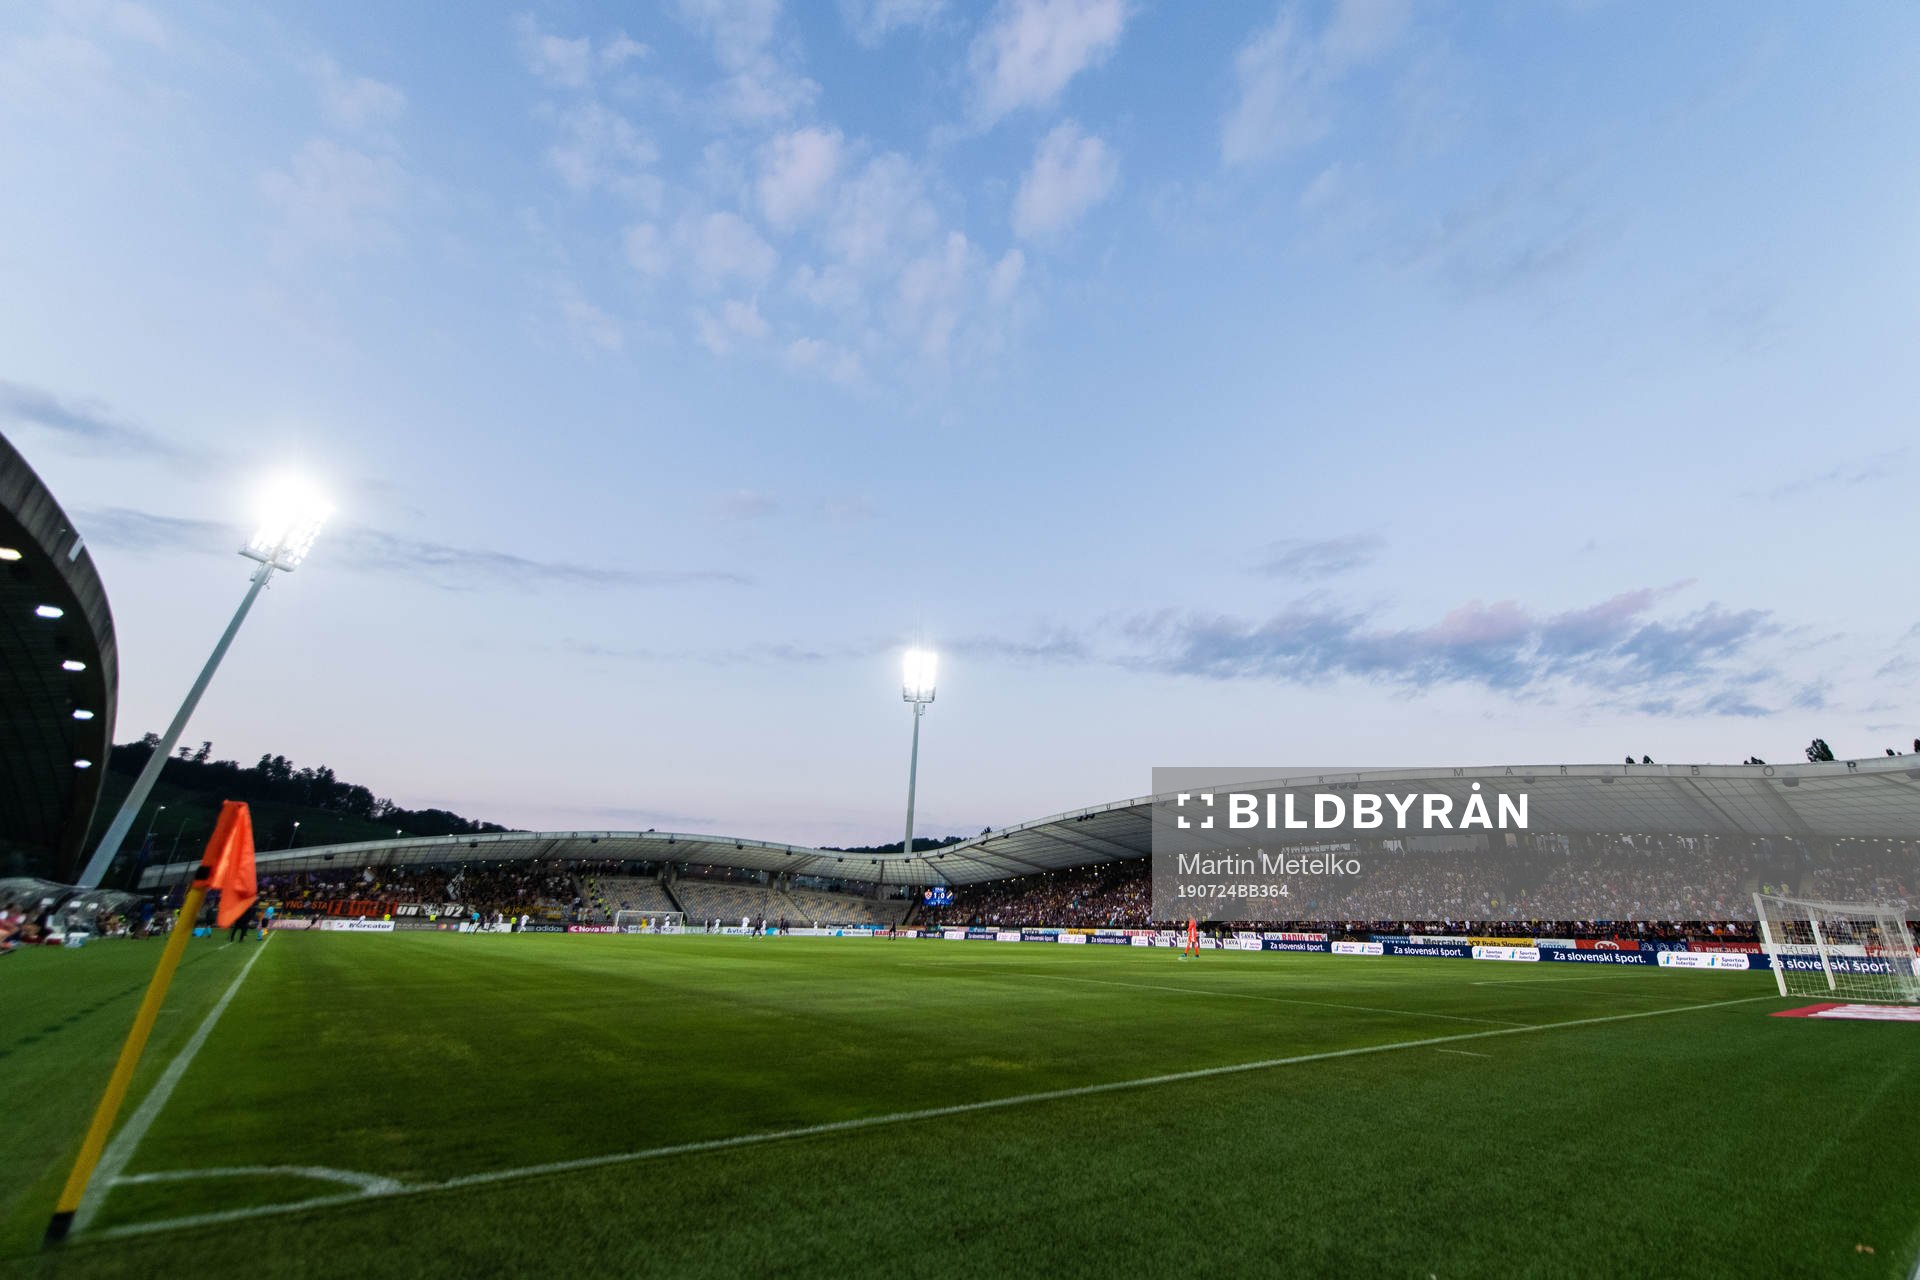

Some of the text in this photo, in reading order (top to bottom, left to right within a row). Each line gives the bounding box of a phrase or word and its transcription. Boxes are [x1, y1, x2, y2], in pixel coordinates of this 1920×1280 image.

[1404, 946, 1439, 955] slovenski
[1440, 947, 1464, 957] šport.
[1553, 951, 1646, 964] Za slovenski šport.
[1787, 959, 1849, 970] sloveski
[1853, 960, 1896, 973] šport.
